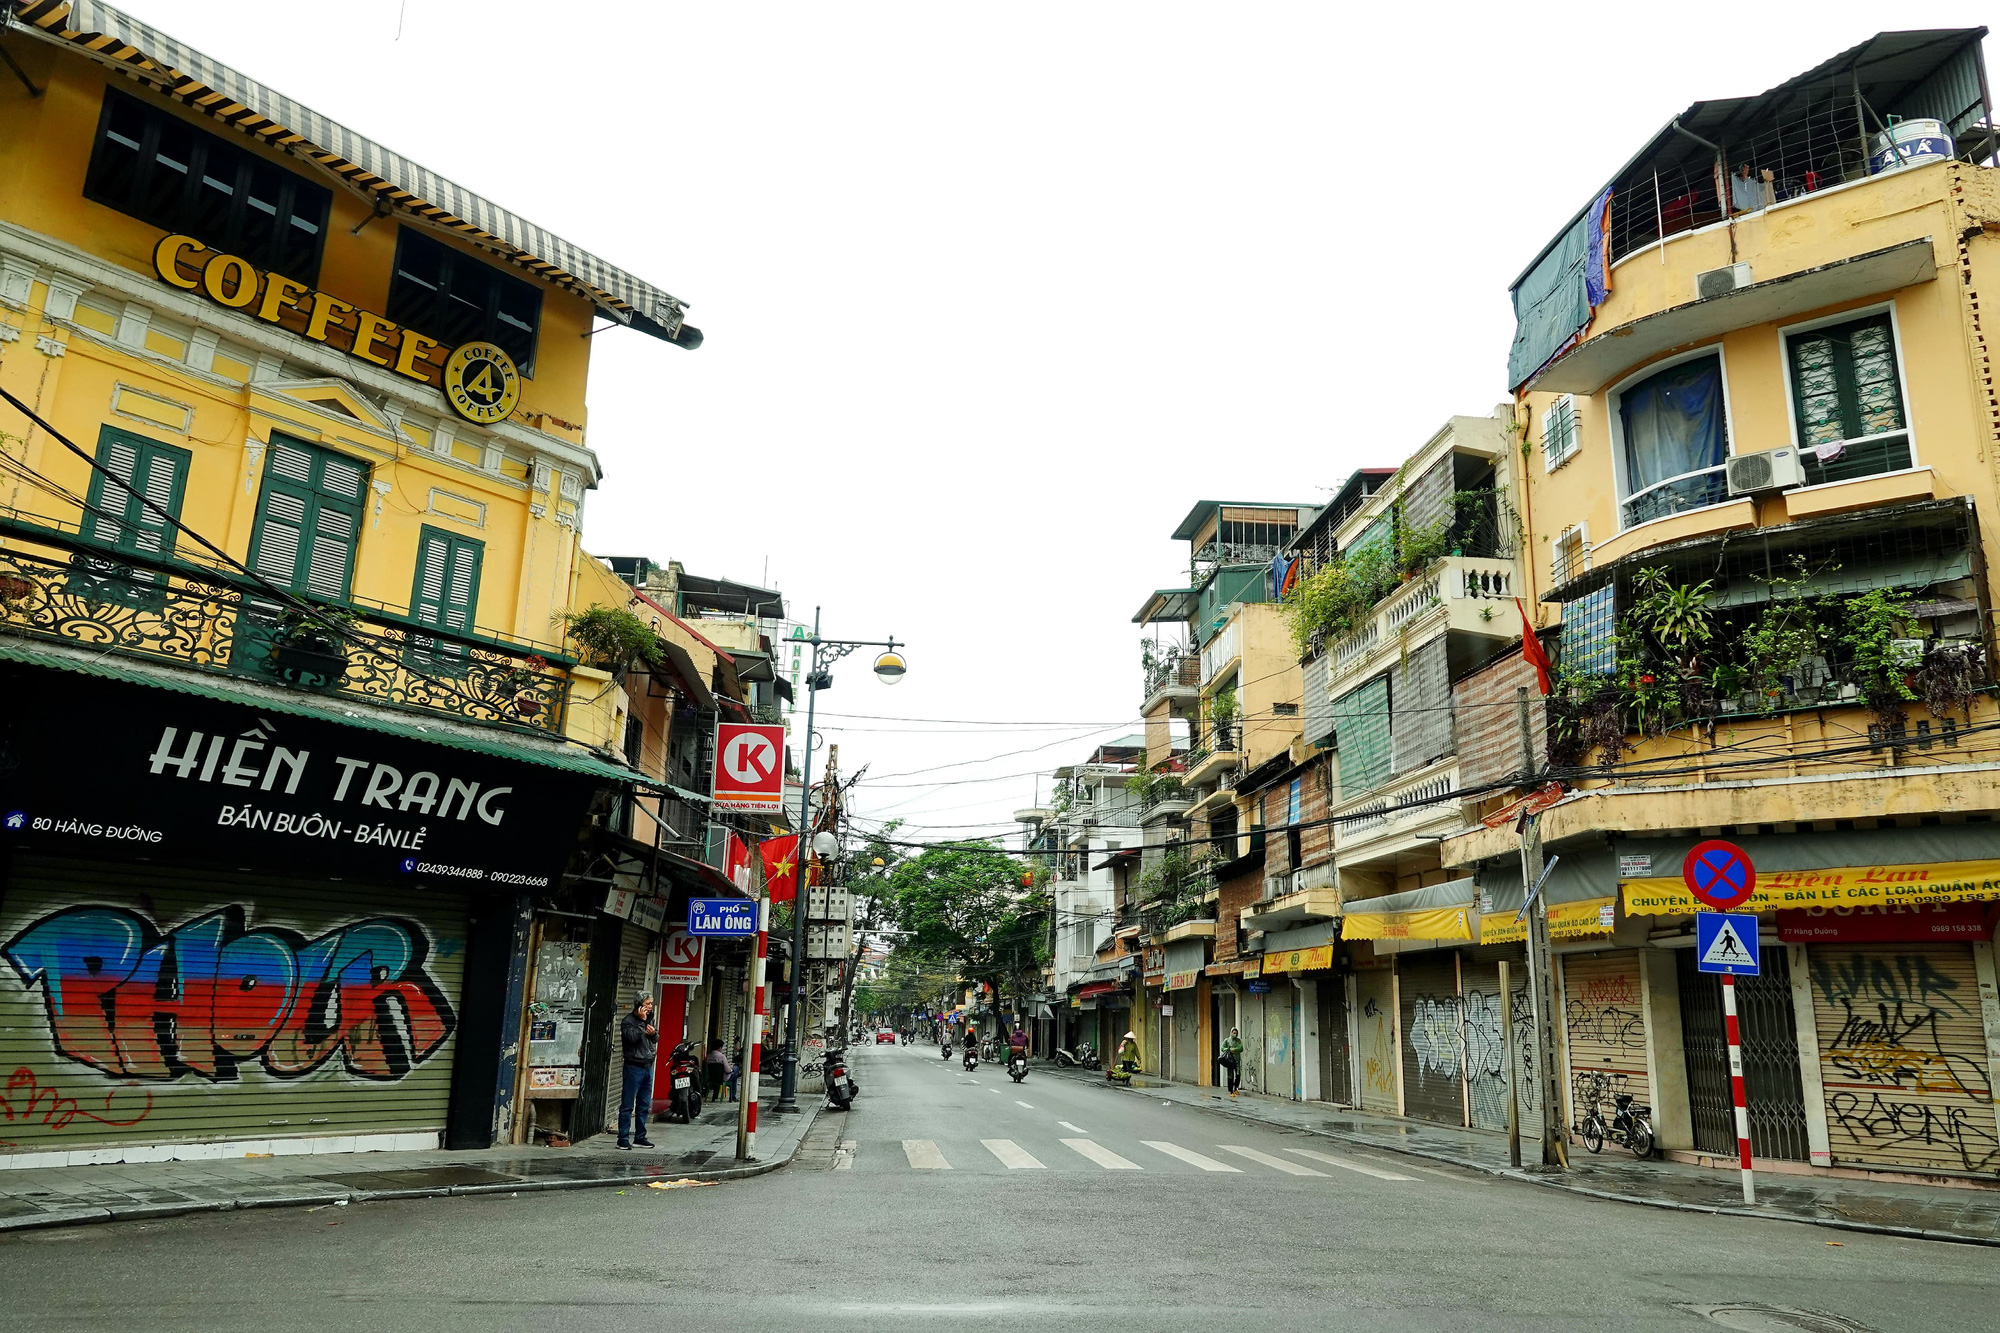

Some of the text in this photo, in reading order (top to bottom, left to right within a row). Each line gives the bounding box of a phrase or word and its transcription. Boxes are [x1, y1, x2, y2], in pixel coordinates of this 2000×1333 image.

[154, 234, 438, 382] COFFEE
[463, 347, 515, 382] COFFEE
[452, 384, 505, 418] COFFEE
[149, 718, 513, 826] HIỀN TRANG
[32, 817, 163, 843] 80 HÀNG ĐƯỜNG
[217, 804, 272, 831] BÁN
[273, 813, 341, 840] BUÔN
[354, 825, 402, 848] BÁN
[400, 826, 427, 850] LẺ
[416, 862, 484, 880] 02439344888
[490, 871, 548, 887] 0902236668
[1763, 866, 1931, 889] Liên Lan
[1632, 895, 1688, 906] CHUYÊN
[1784, 887, 1819, 901] BÁN
[1821, 886, 1840, 899] LẺ
[1847, 885, 1880, 897] CÁC
[1885, 885, 1927, 897] LOẠI
[1928, 878, 1975, 894] QUẦN
[1886, 897, 1909, 905] ĐT:
[1914, 895, 1951, 904] 0989
[1957, 893, 1985, 901] 158
[719, 904, 740, 913] PHỐ
[695, 914, 752, 930] LÃN ÔNG
[1794, 927, 1813, 936] Hàng
